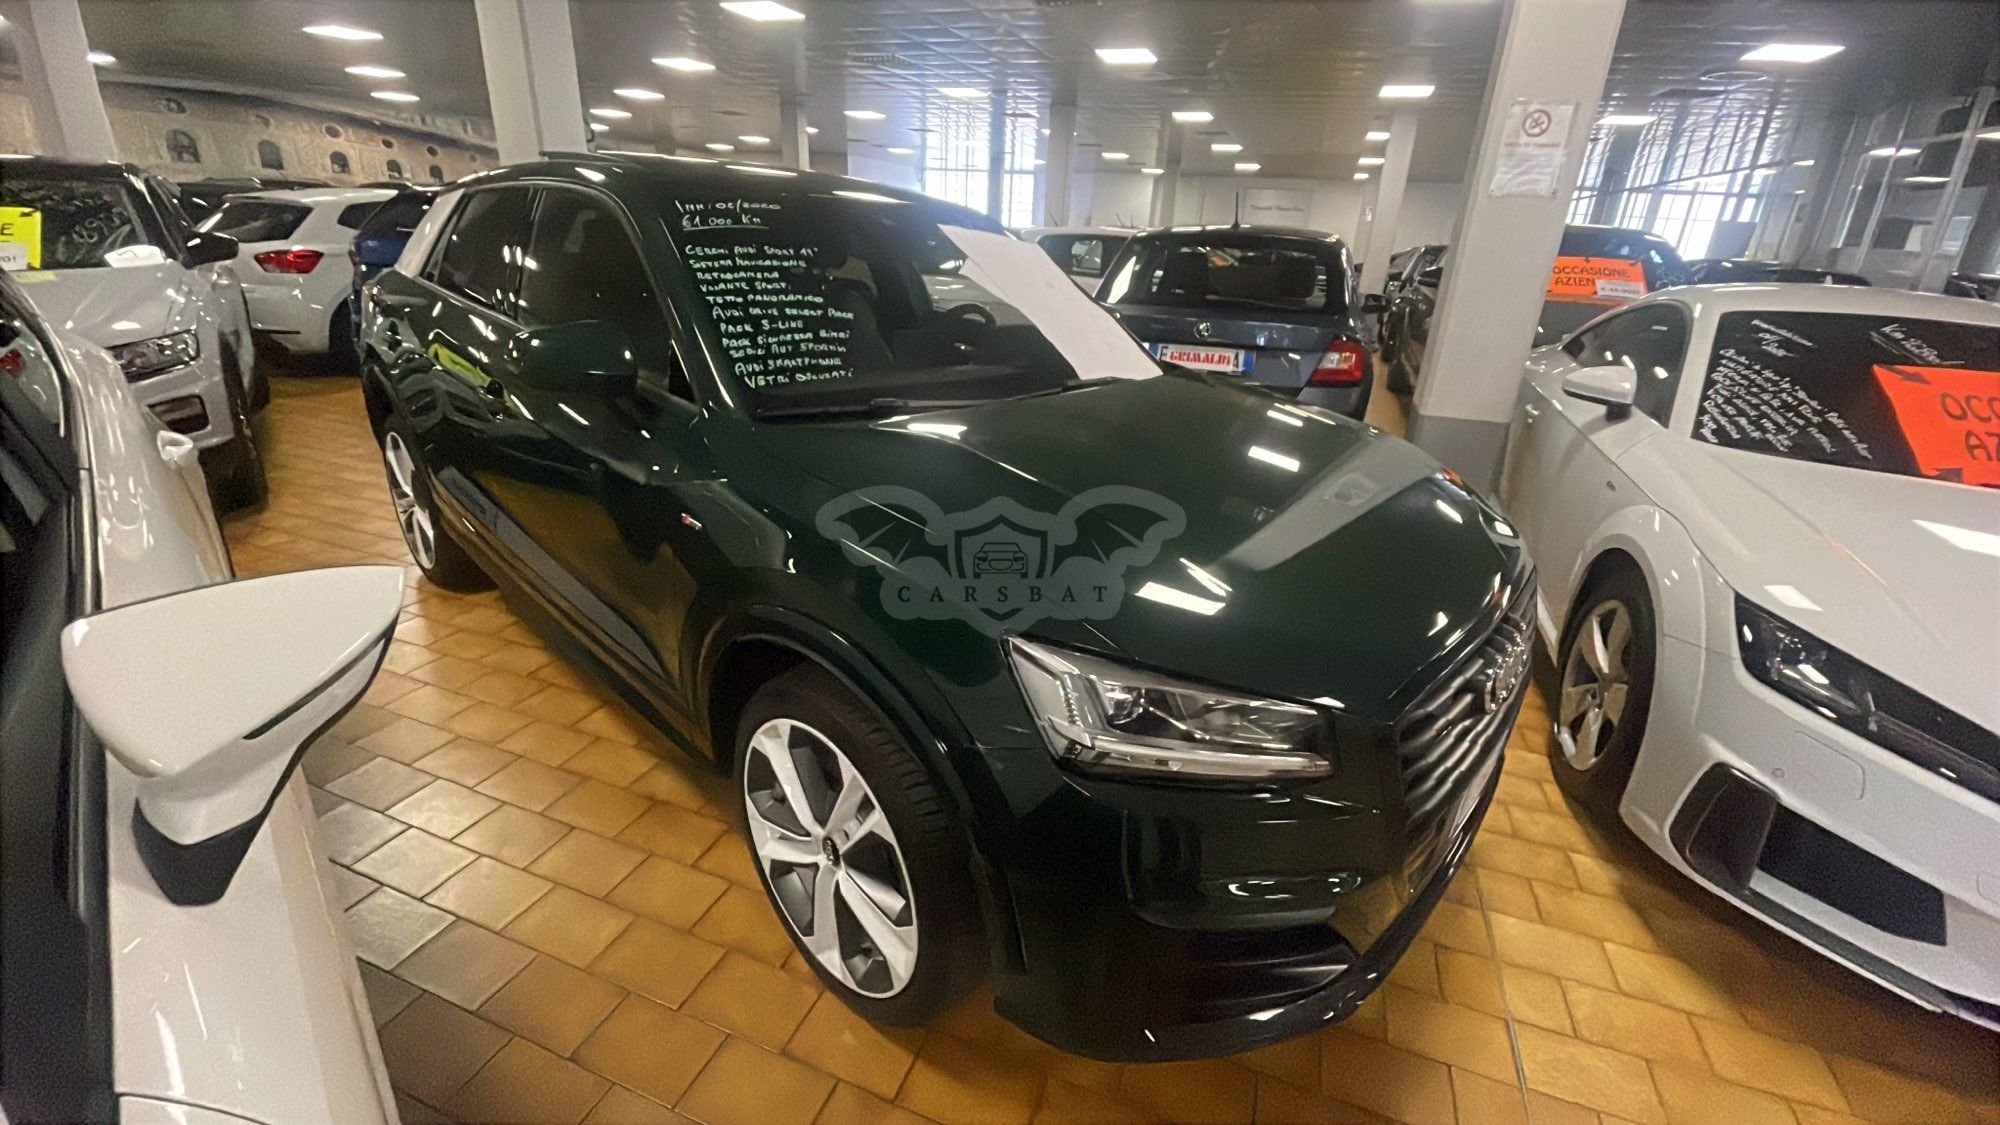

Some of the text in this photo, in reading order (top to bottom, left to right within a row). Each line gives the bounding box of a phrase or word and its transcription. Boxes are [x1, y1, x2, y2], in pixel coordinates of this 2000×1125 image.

[1552, 265, 1631, 279] OCCASIONE
[705, 295, 744, 304] TETTO
[1169, 350, 1231, 366] GRIMALDI
